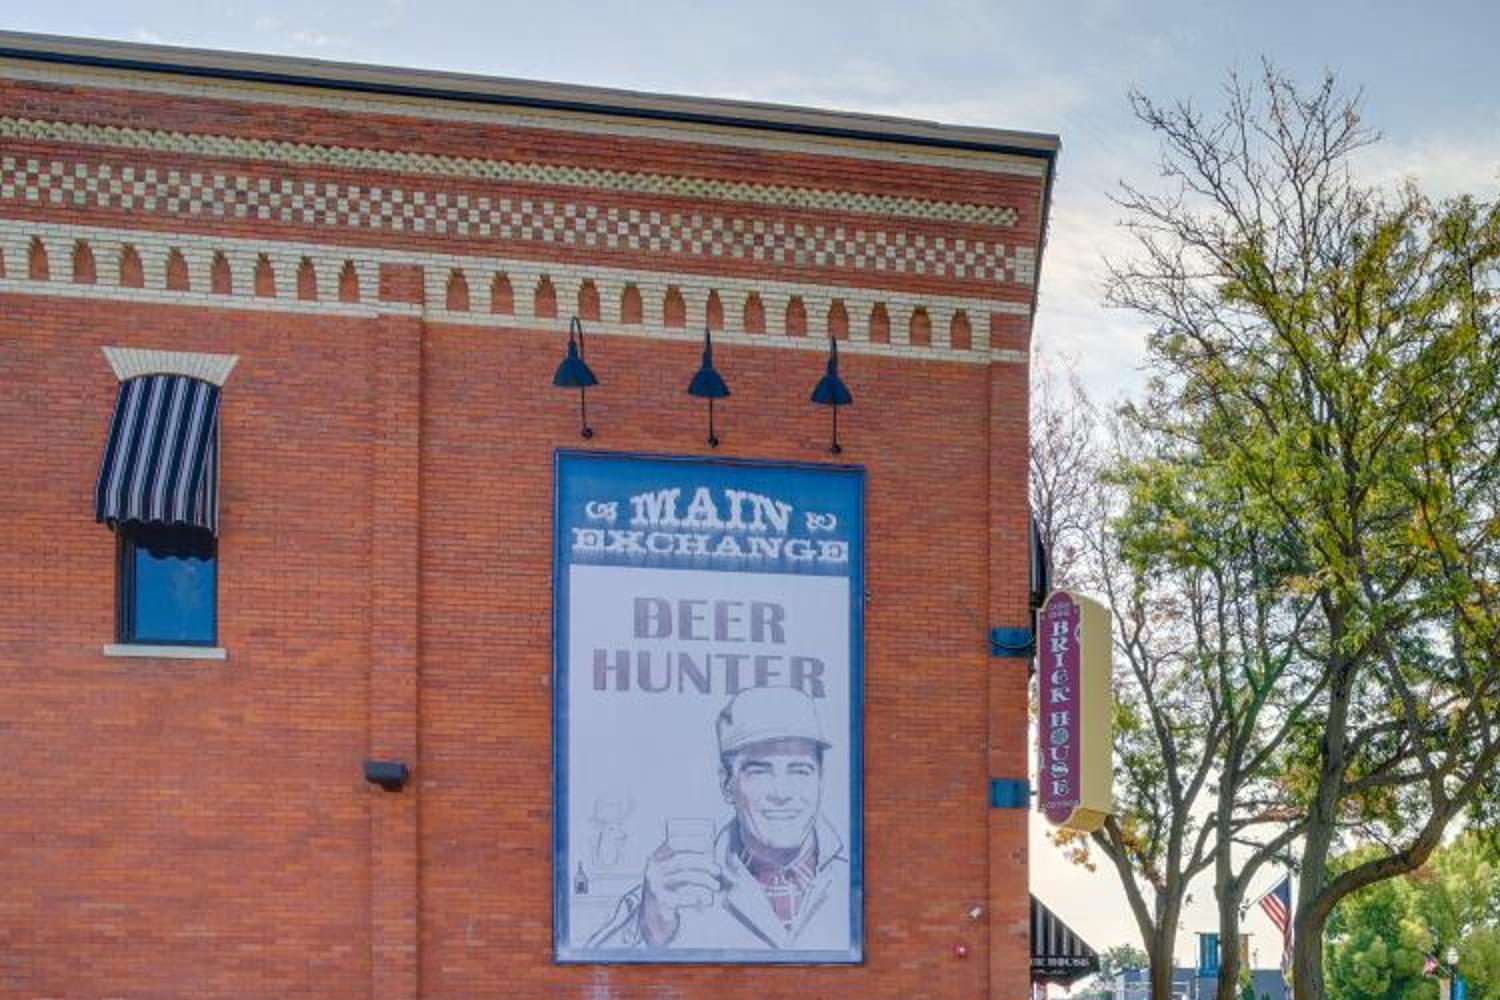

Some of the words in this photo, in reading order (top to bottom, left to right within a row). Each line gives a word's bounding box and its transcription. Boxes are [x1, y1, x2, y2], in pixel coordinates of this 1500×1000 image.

[630, 487, 792, 532] MAIN
[571, 527, 849, 562] EXCHANGE
[592, 648, 826, 698] HUNTER
[1050, 620, 1070, 704] BRICK
[1050, 711, 1070, 796] HOUSE
